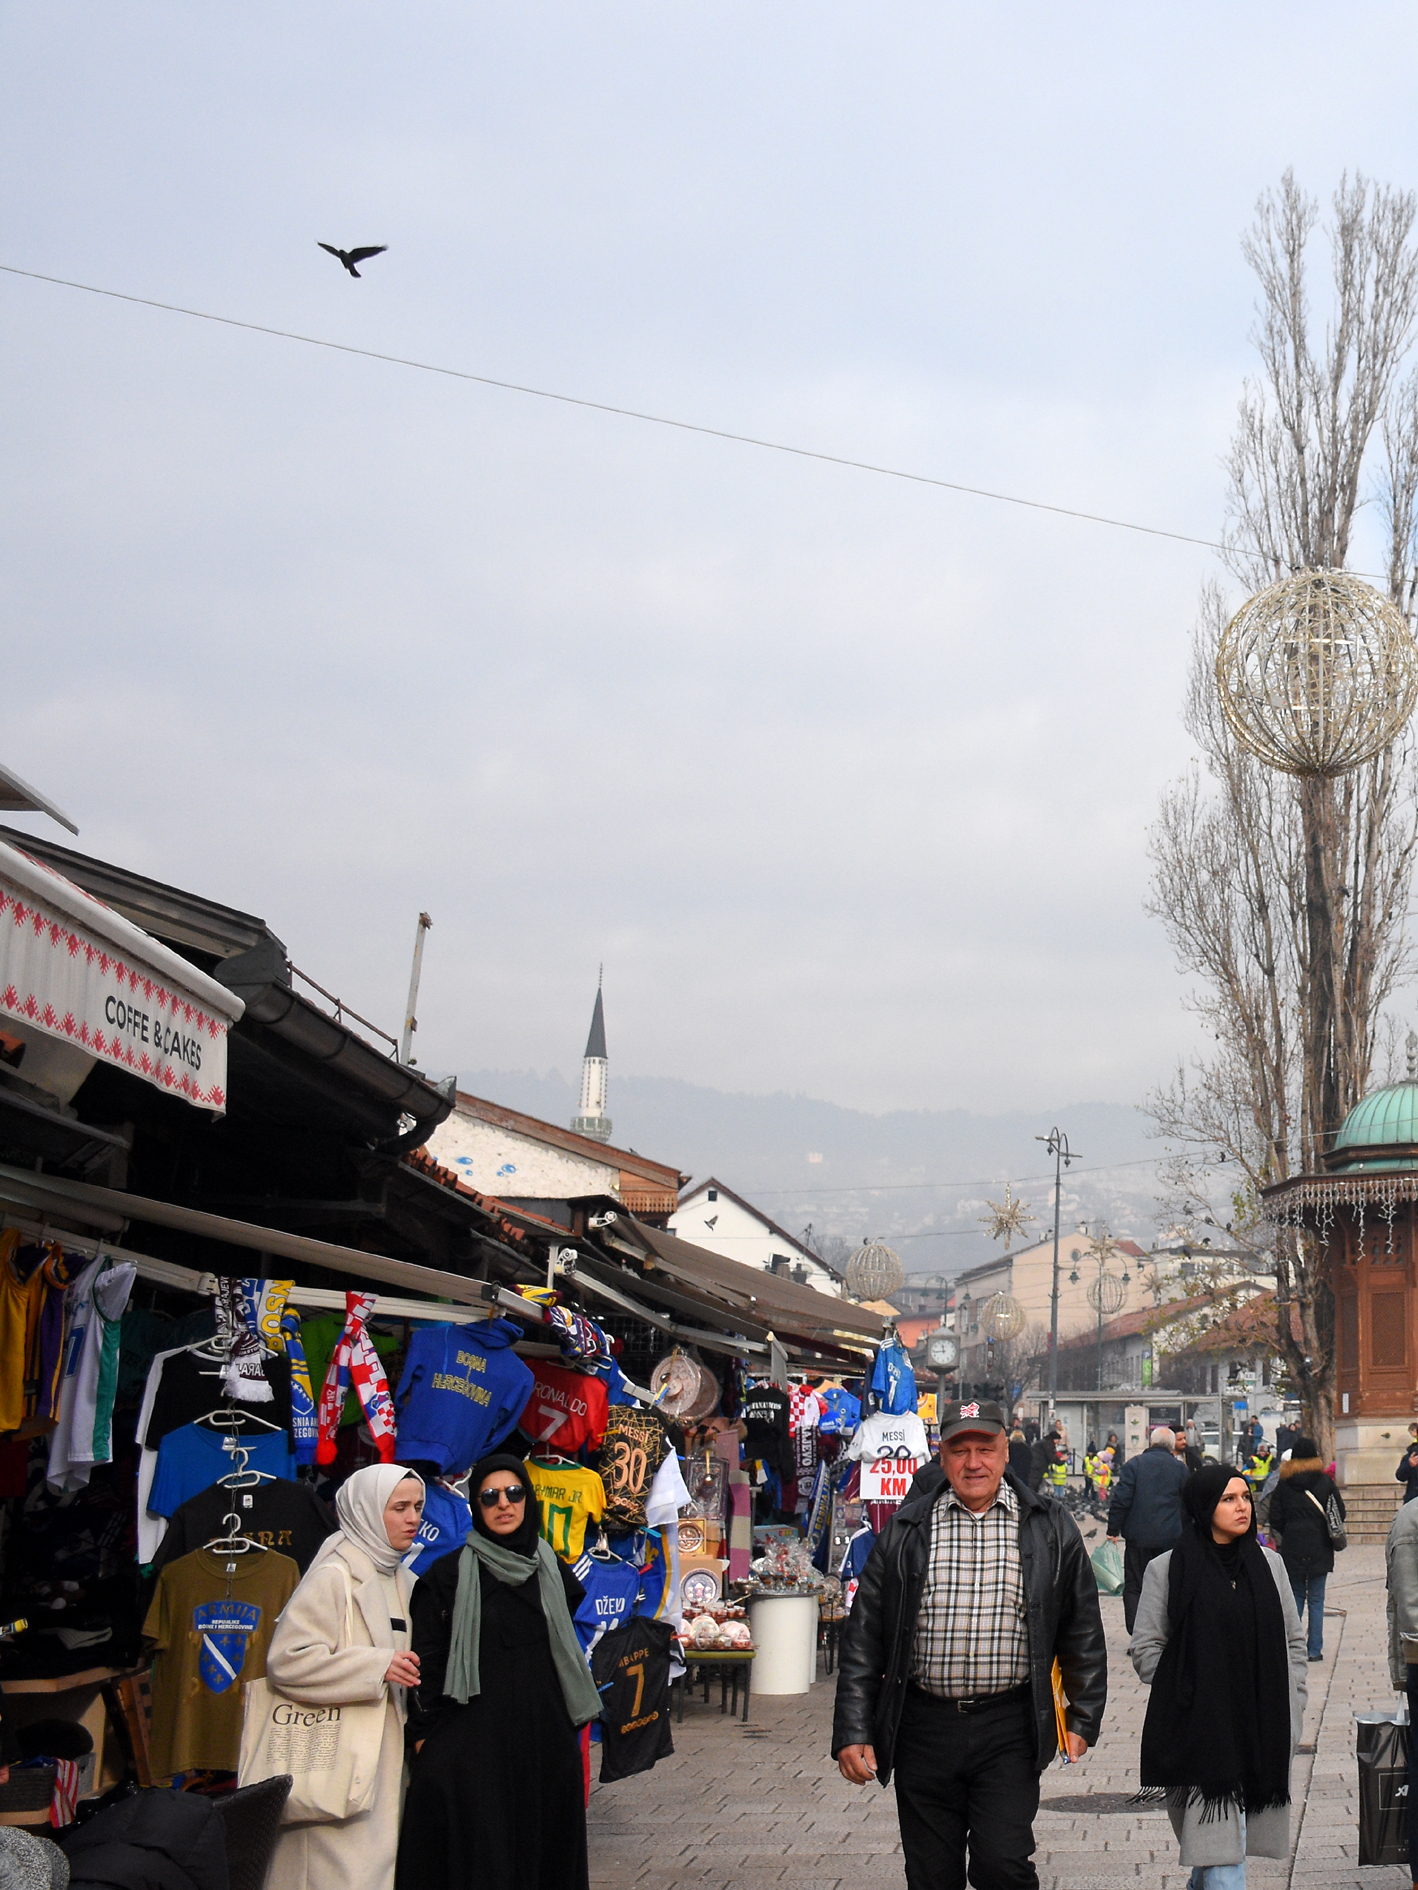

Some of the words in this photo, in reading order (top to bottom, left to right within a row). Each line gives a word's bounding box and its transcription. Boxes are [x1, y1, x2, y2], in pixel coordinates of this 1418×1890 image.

[105, 995, 149, 1043] COFFE
[154, 1020, 163, 1049] &
[163, 1026, 202, 1071] CAKES
[456, 1350, 487, 1374] BOSNA
[533, 1381, 588, 1417] RONALDO
[537, 1404, 570, 1442] 7
[613, 1441, 647, 1495] 30
[870, 1458, 917, 1475] 25,00
[533, 1484, 566, 1500] EYMAR
[881, 1478, 906, 1496] KM
[198, 1604, 257, 1621] ARMIJA
[626, 1663, 645, 1717] 7
[272, 1703, 341, 1727] Green
